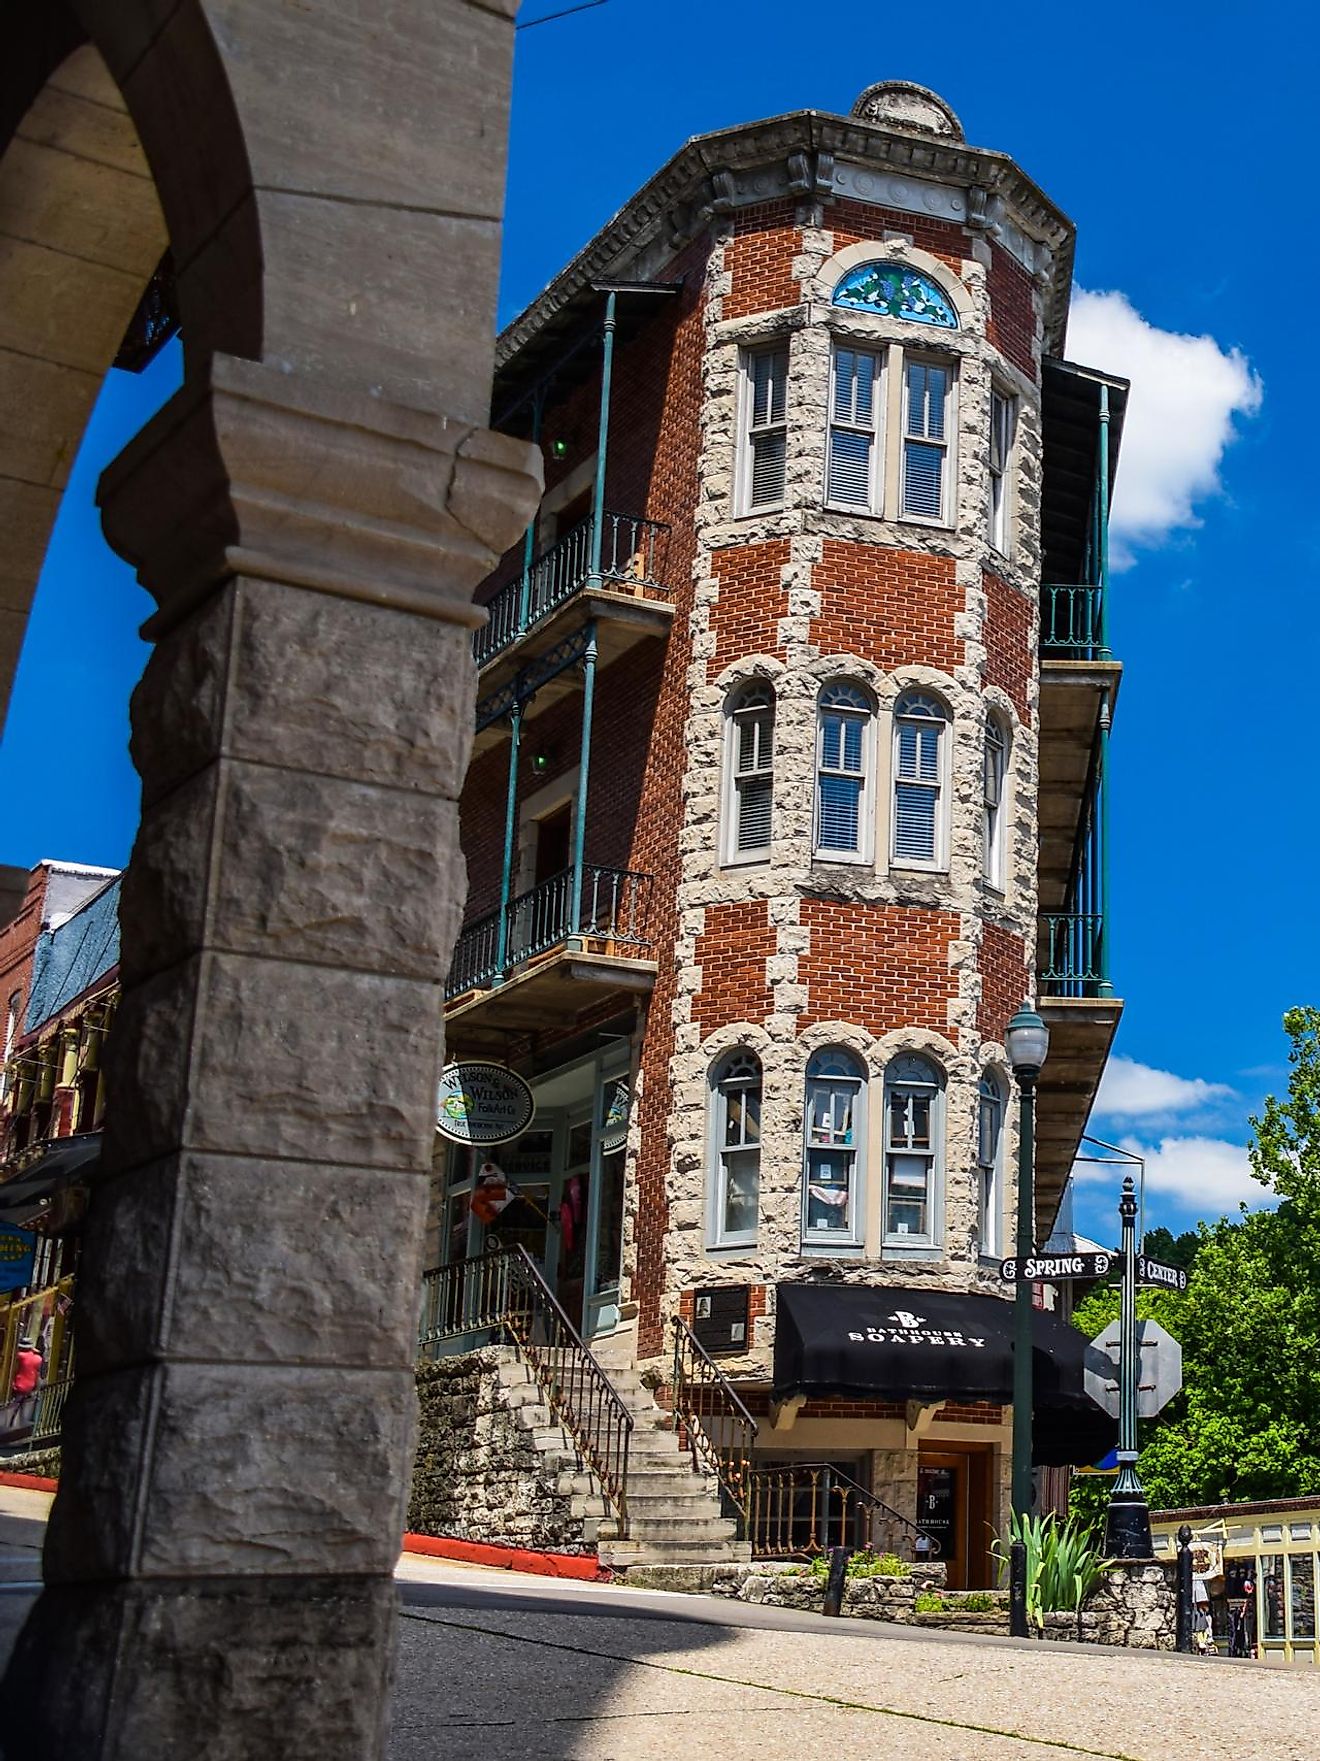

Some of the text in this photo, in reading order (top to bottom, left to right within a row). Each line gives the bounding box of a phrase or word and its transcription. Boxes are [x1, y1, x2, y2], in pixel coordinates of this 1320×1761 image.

[469, 1085, 518, 1101] WILSON
[1024, 1257, 1085, 1278] SPRING
[1146, 1262, 1178, 1288] CENTER
[848, 1332, 985, 1347] SOAPERY
[866, 1327, 963, 1338] BATHHOUSE
